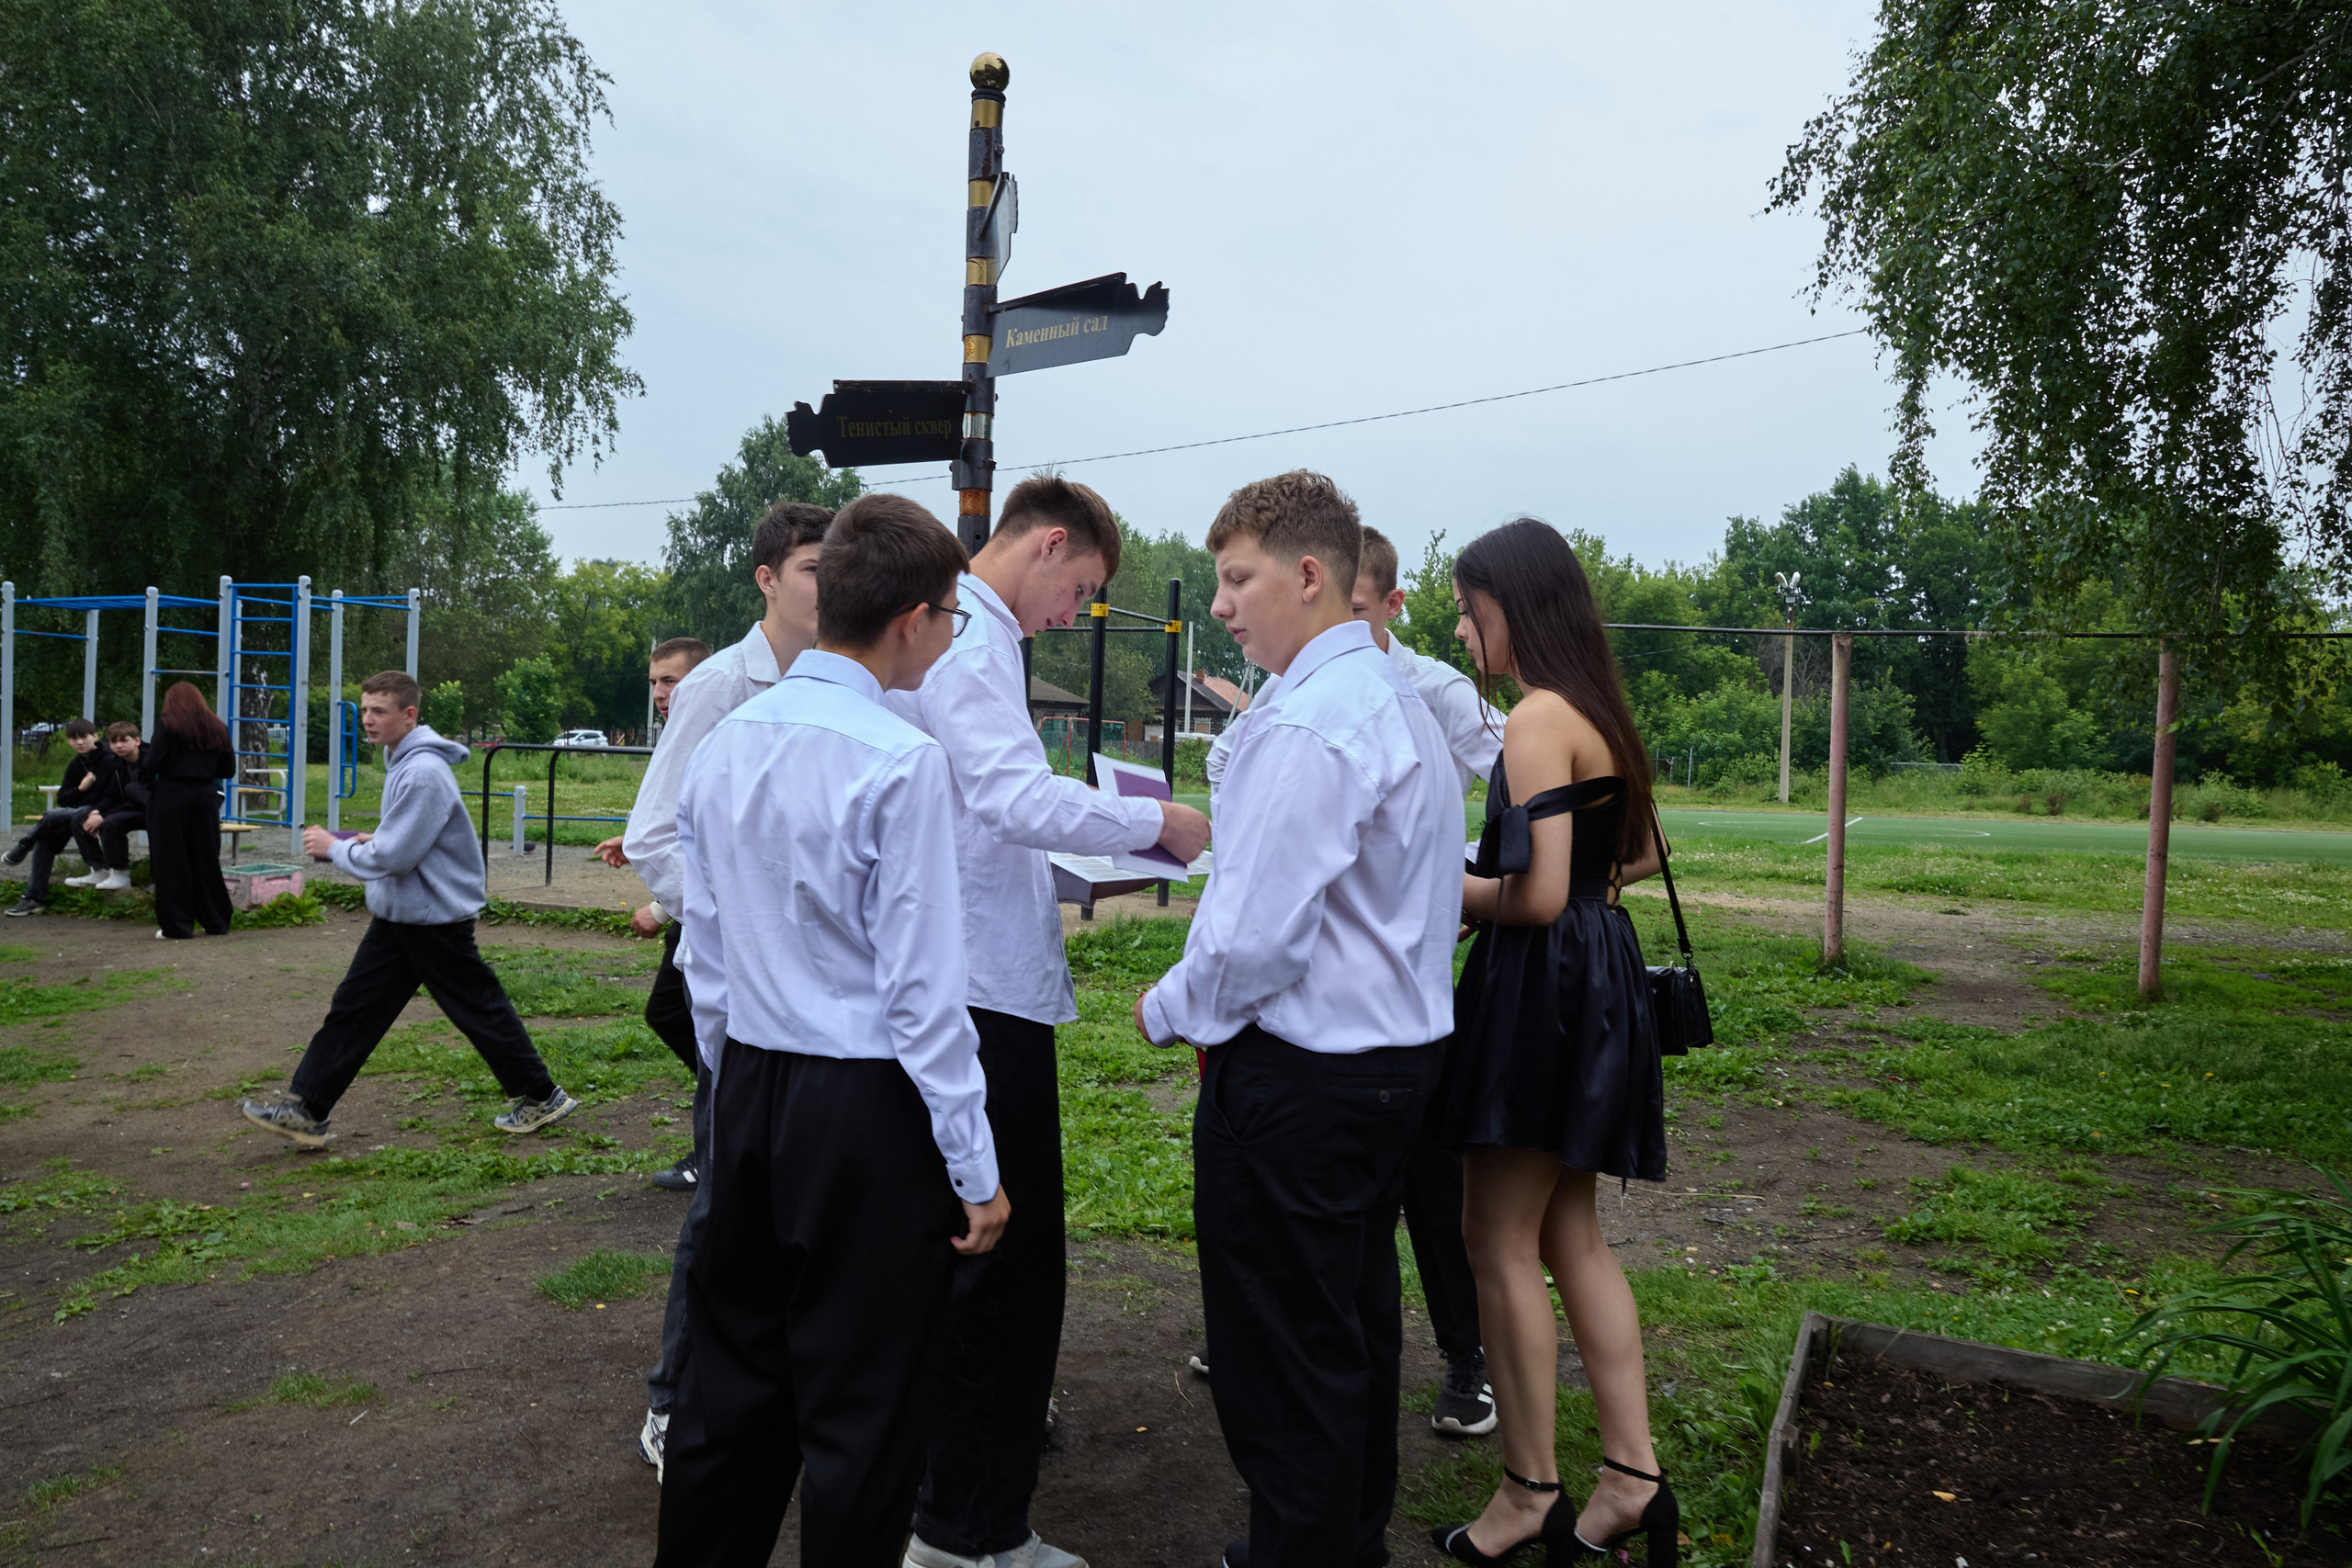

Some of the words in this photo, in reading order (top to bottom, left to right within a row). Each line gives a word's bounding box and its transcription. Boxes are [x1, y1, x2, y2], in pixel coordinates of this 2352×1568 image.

[1005, 316, 1080, 348] Каменный
[1084, 315, 1109, 333] сад
[836, 415, 910, 438] Тенистый
[914, 420, 952, 440] сквер
